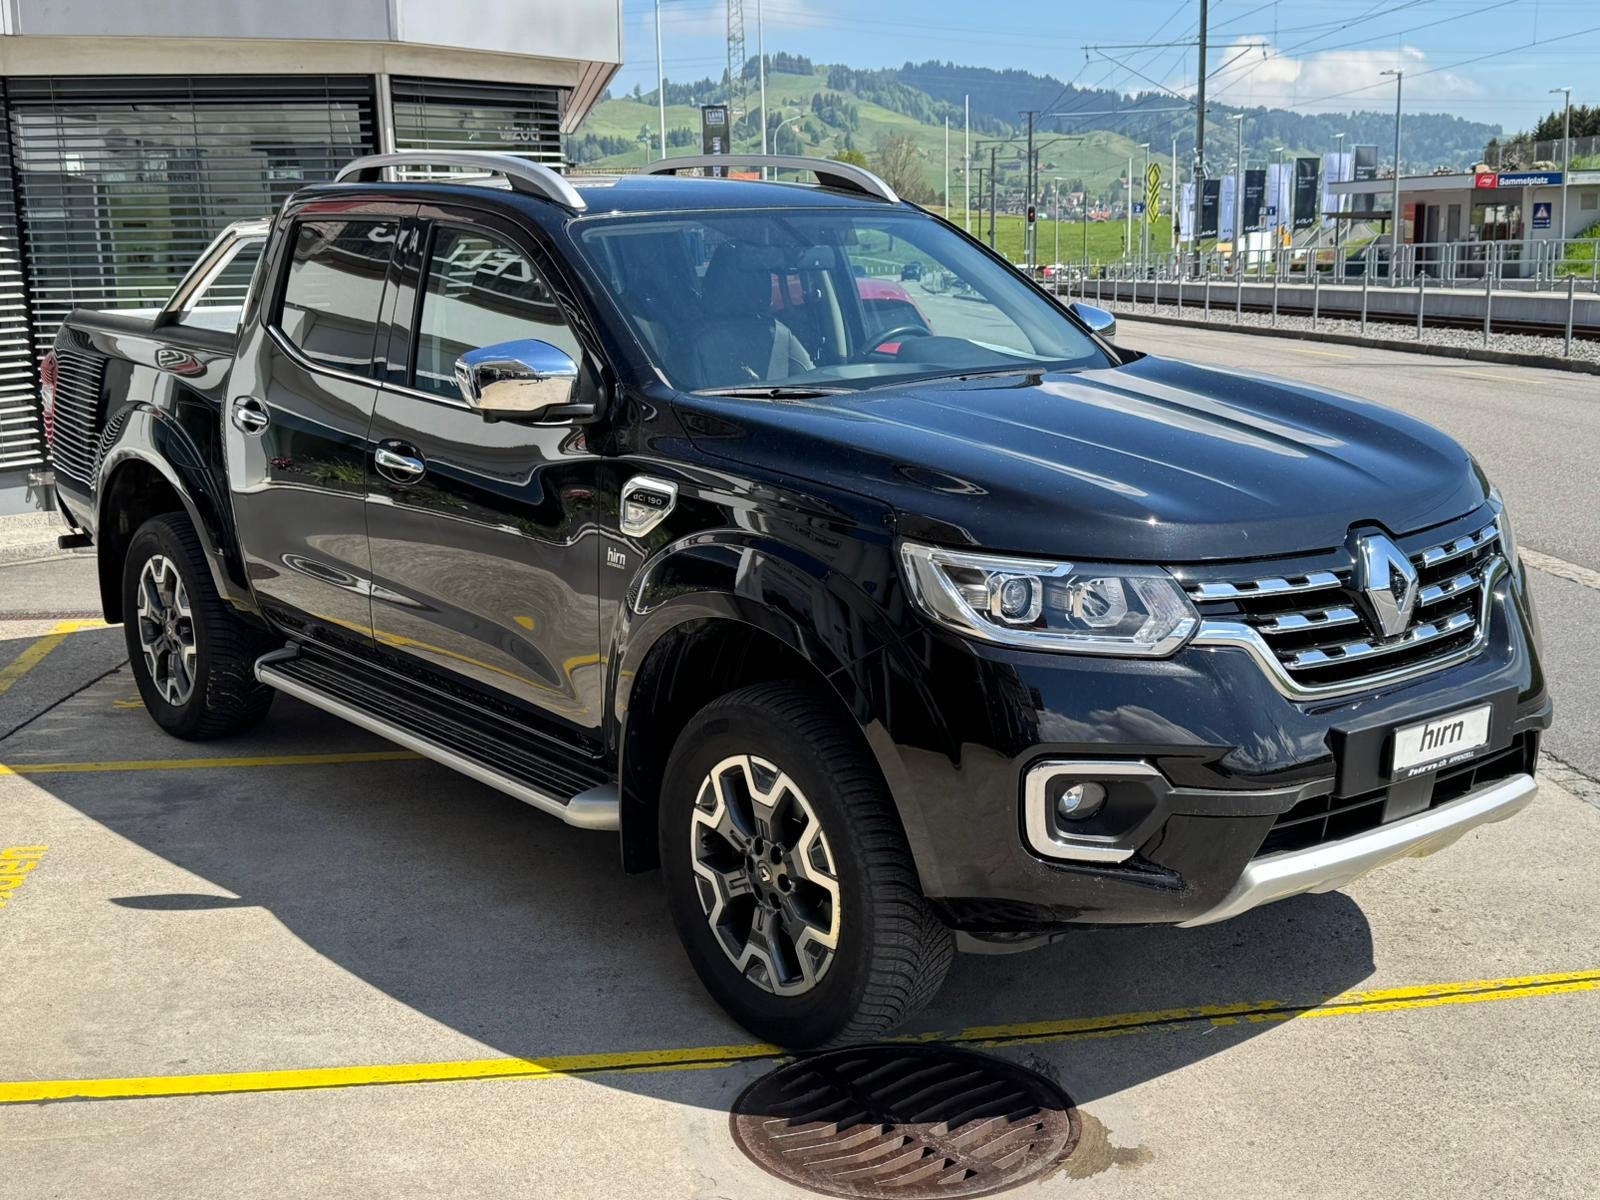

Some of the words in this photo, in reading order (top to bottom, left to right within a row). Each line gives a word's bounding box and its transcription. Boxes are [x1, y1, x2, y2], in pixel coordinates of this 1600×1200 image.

[1499, 176, 1549, 186] Sammelplatz
[647, 496, 662, 506] 190
[607, 546, 626, 566] hirn
[1418, 720, 1464, 752] hirn
